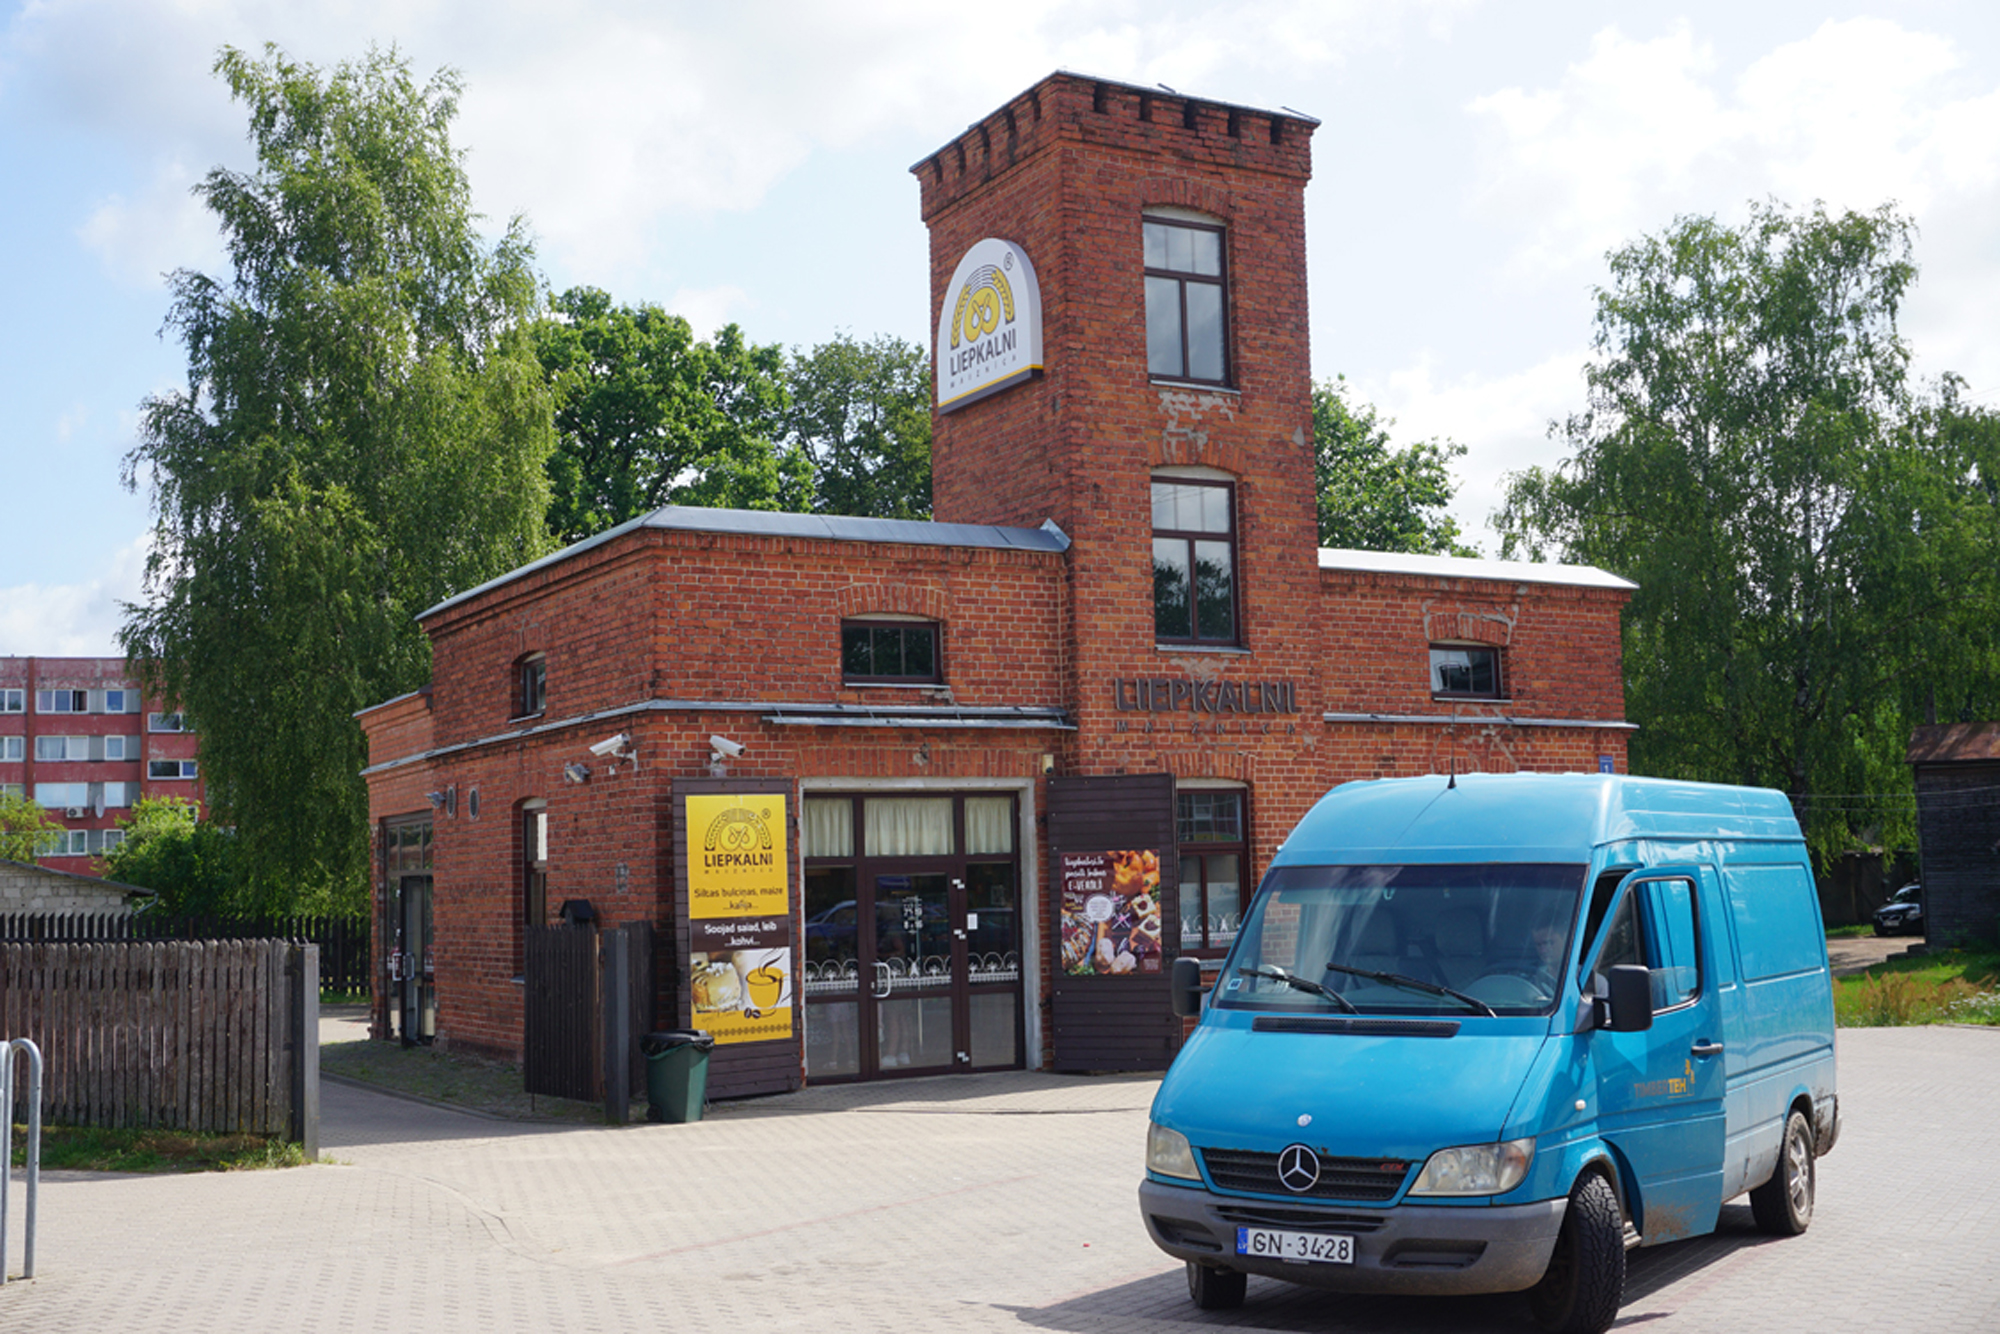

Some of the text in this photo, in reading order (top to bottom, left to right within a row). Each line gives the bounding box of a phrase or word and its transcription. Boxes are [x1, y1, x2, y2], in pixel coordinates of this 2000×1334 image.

[949, 328, 1017, 377] LIEPKALNI
[1115, 677, 1297, 714] LIEPKALNI
[704, 852, 773, 868] LIEPKALNI
[760, 885, 783, 896] maize
[704, 923, 736, 936] Soojad
[1380, 1162, 1405, 1171] CDI
